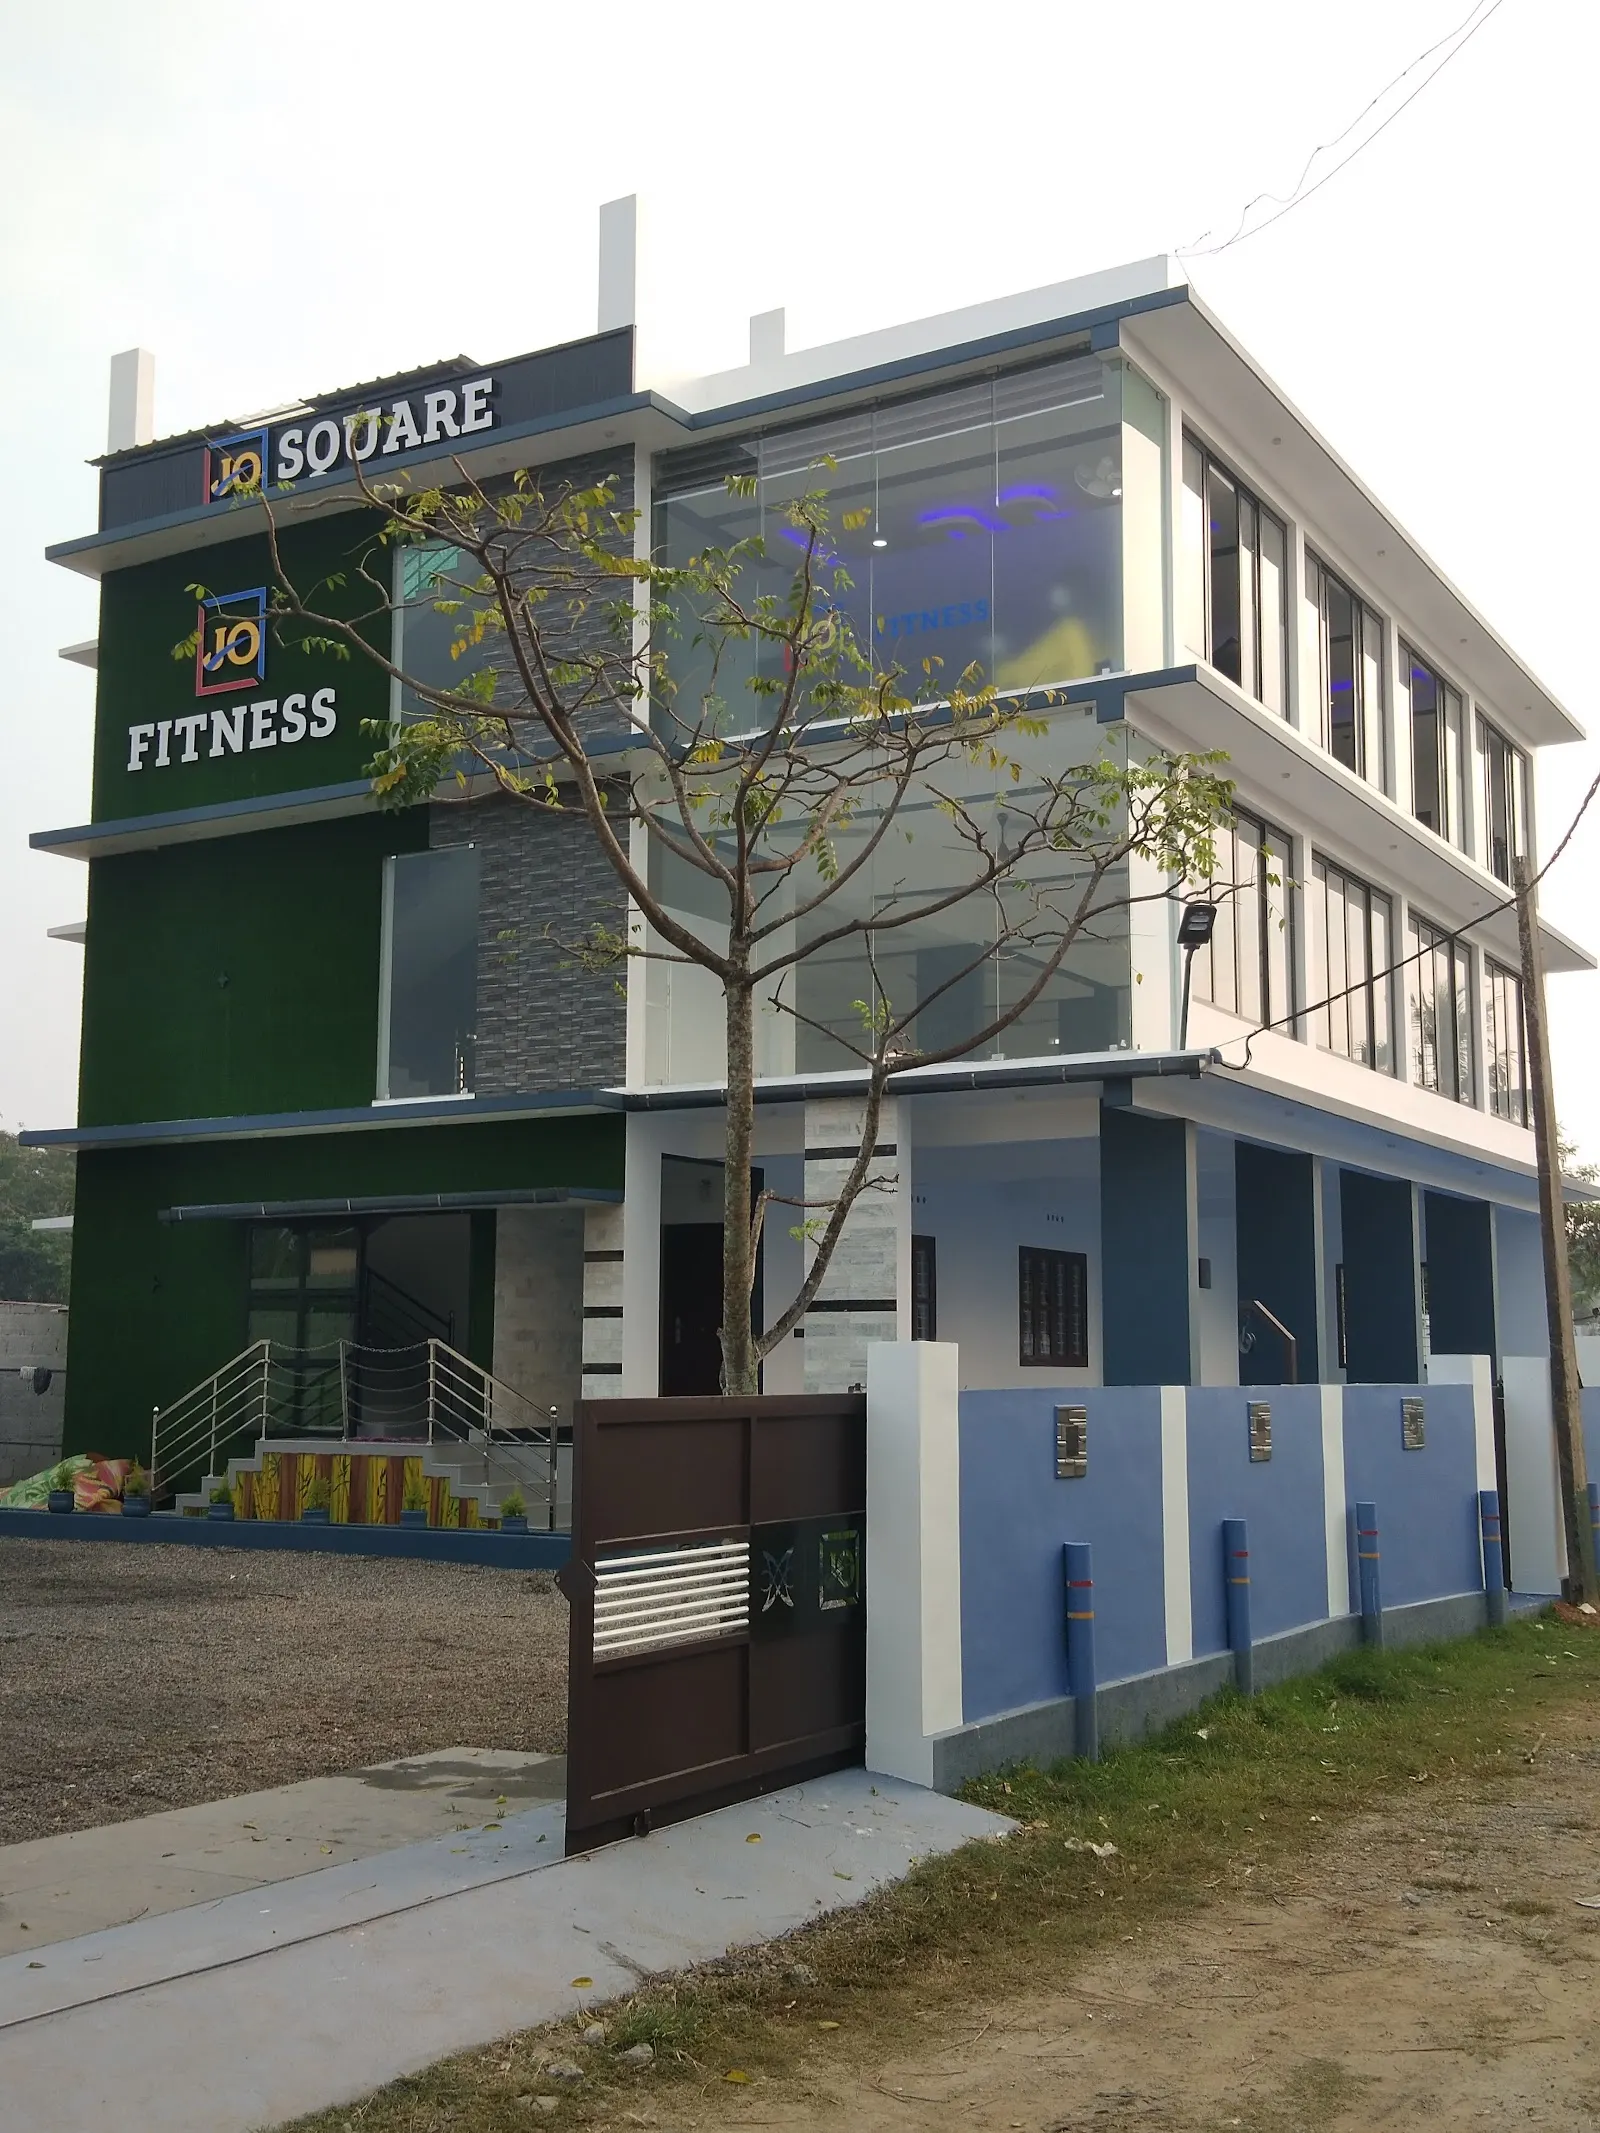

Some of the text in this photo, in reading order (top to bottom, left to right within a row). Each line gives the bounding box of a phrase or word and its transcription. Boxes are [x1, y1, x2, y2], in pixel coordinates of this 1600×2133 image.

[277, 377, 493, 479] SQUARE
[202, 621, 260, 671] JO
[127, 688, 337, 771] FITNESS
